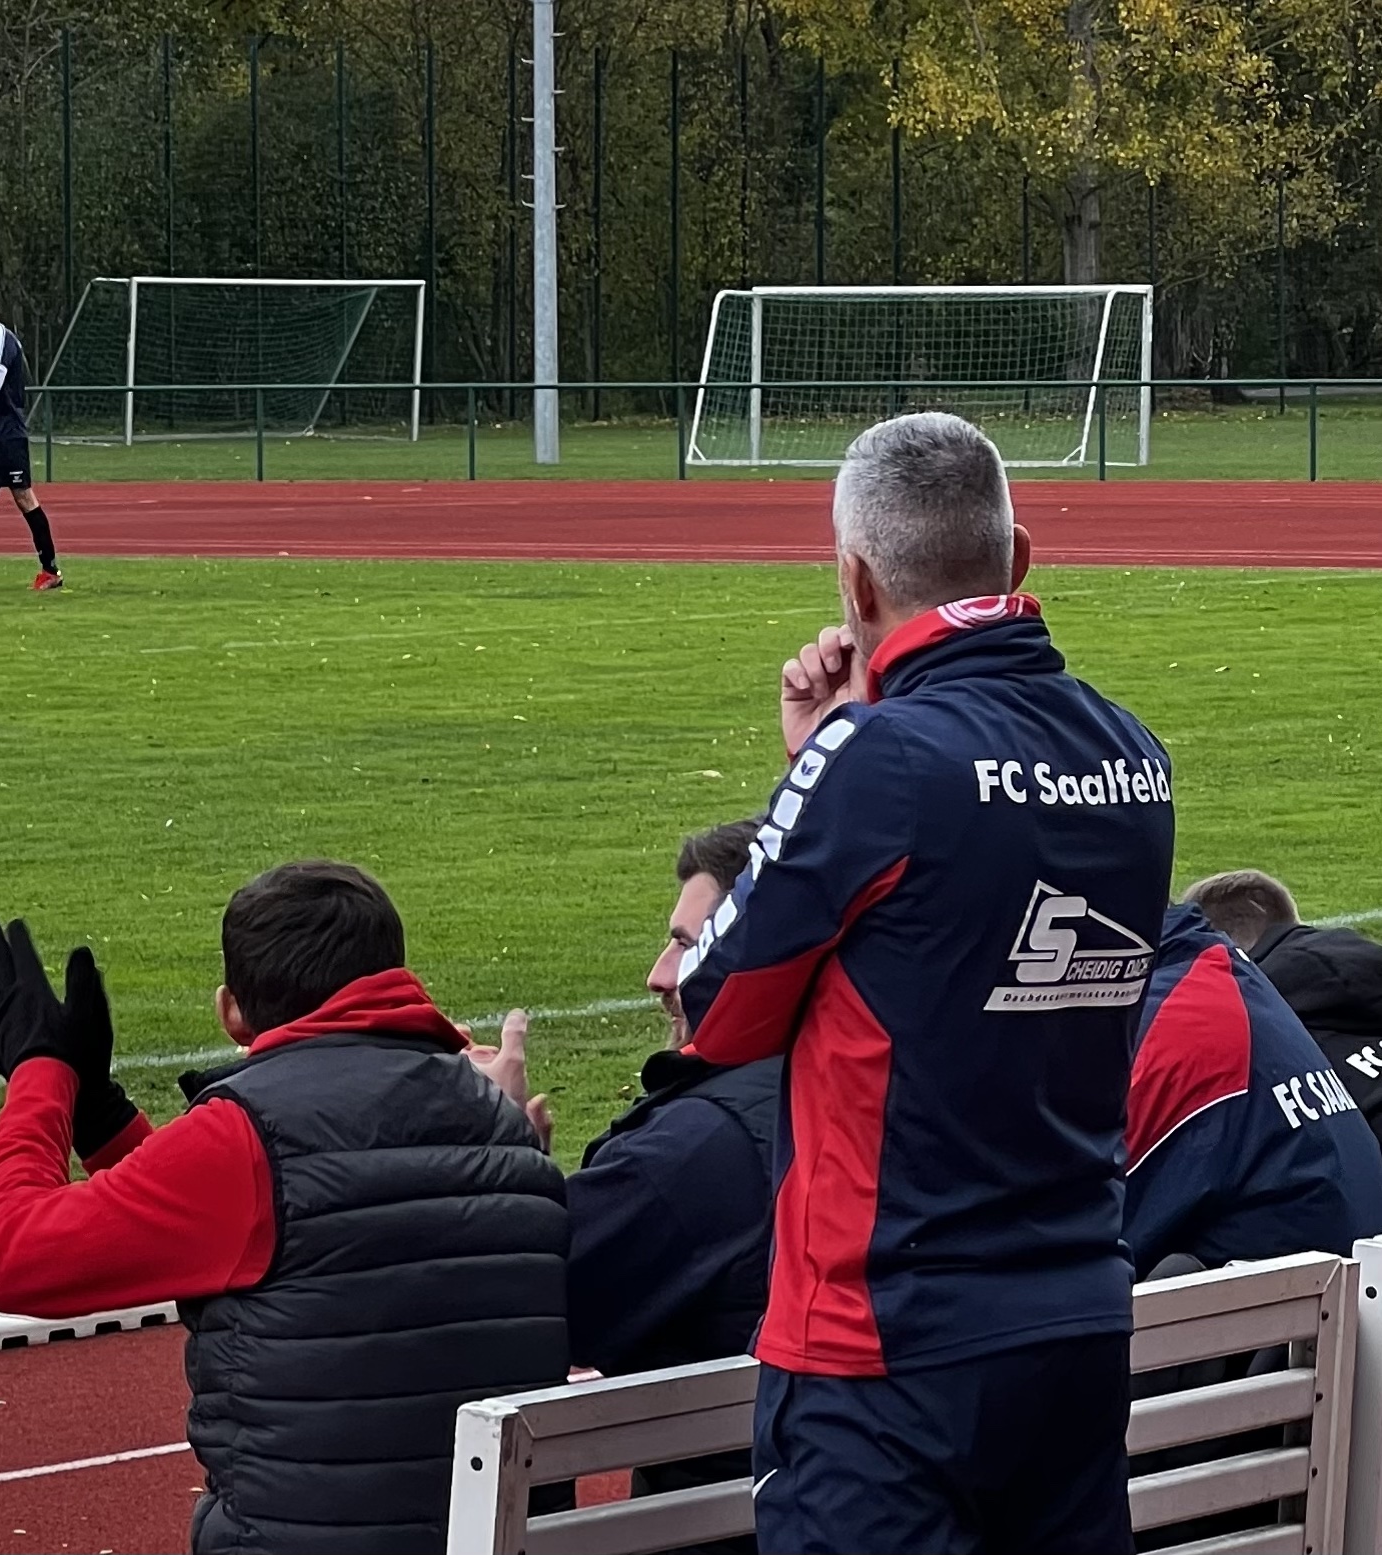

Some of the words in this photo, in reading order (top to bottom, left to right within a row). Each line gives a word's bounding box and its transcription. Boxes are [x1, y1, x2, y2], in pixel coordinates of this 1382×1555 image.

[974, 759, 1028, 803] FC
[1034, 758, 1172, 805] Saalfeld
[1272, 1075, 1320, 1129] FC
